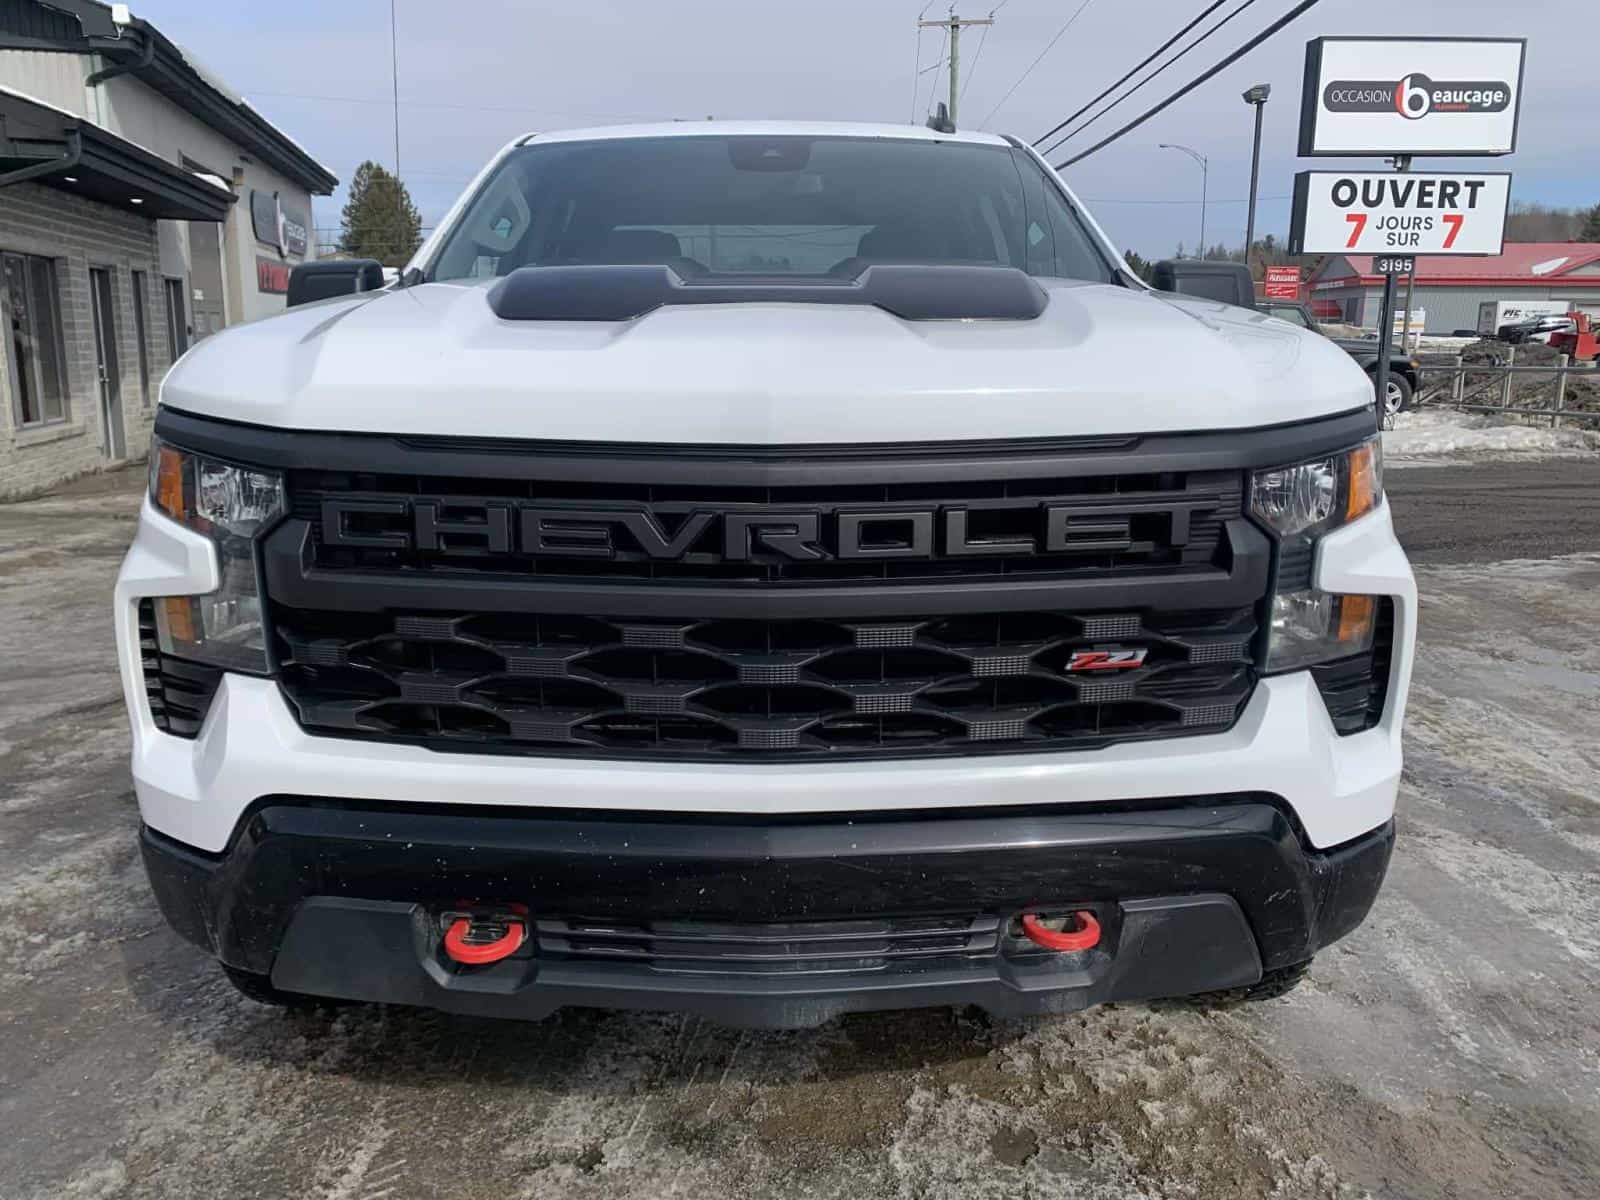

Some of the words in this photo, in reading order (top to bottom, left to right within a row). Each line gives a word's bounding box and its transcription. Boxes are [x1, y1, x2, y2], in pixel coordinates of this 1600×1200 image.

[1331, 90, 1392, 103] OCCASION
[1331, 179, 1485, 209] OUVERT
[1345, 213, 1368, 249] 7
[1376, 216, 1433, 231] JOURS
[1442, 214, 1465, 249] 7
[1386, 232, 1420, 247] SUR
[1379, 259, 1413, 272] 3195
[321, 496, 1200, 563] CHEVROLET
